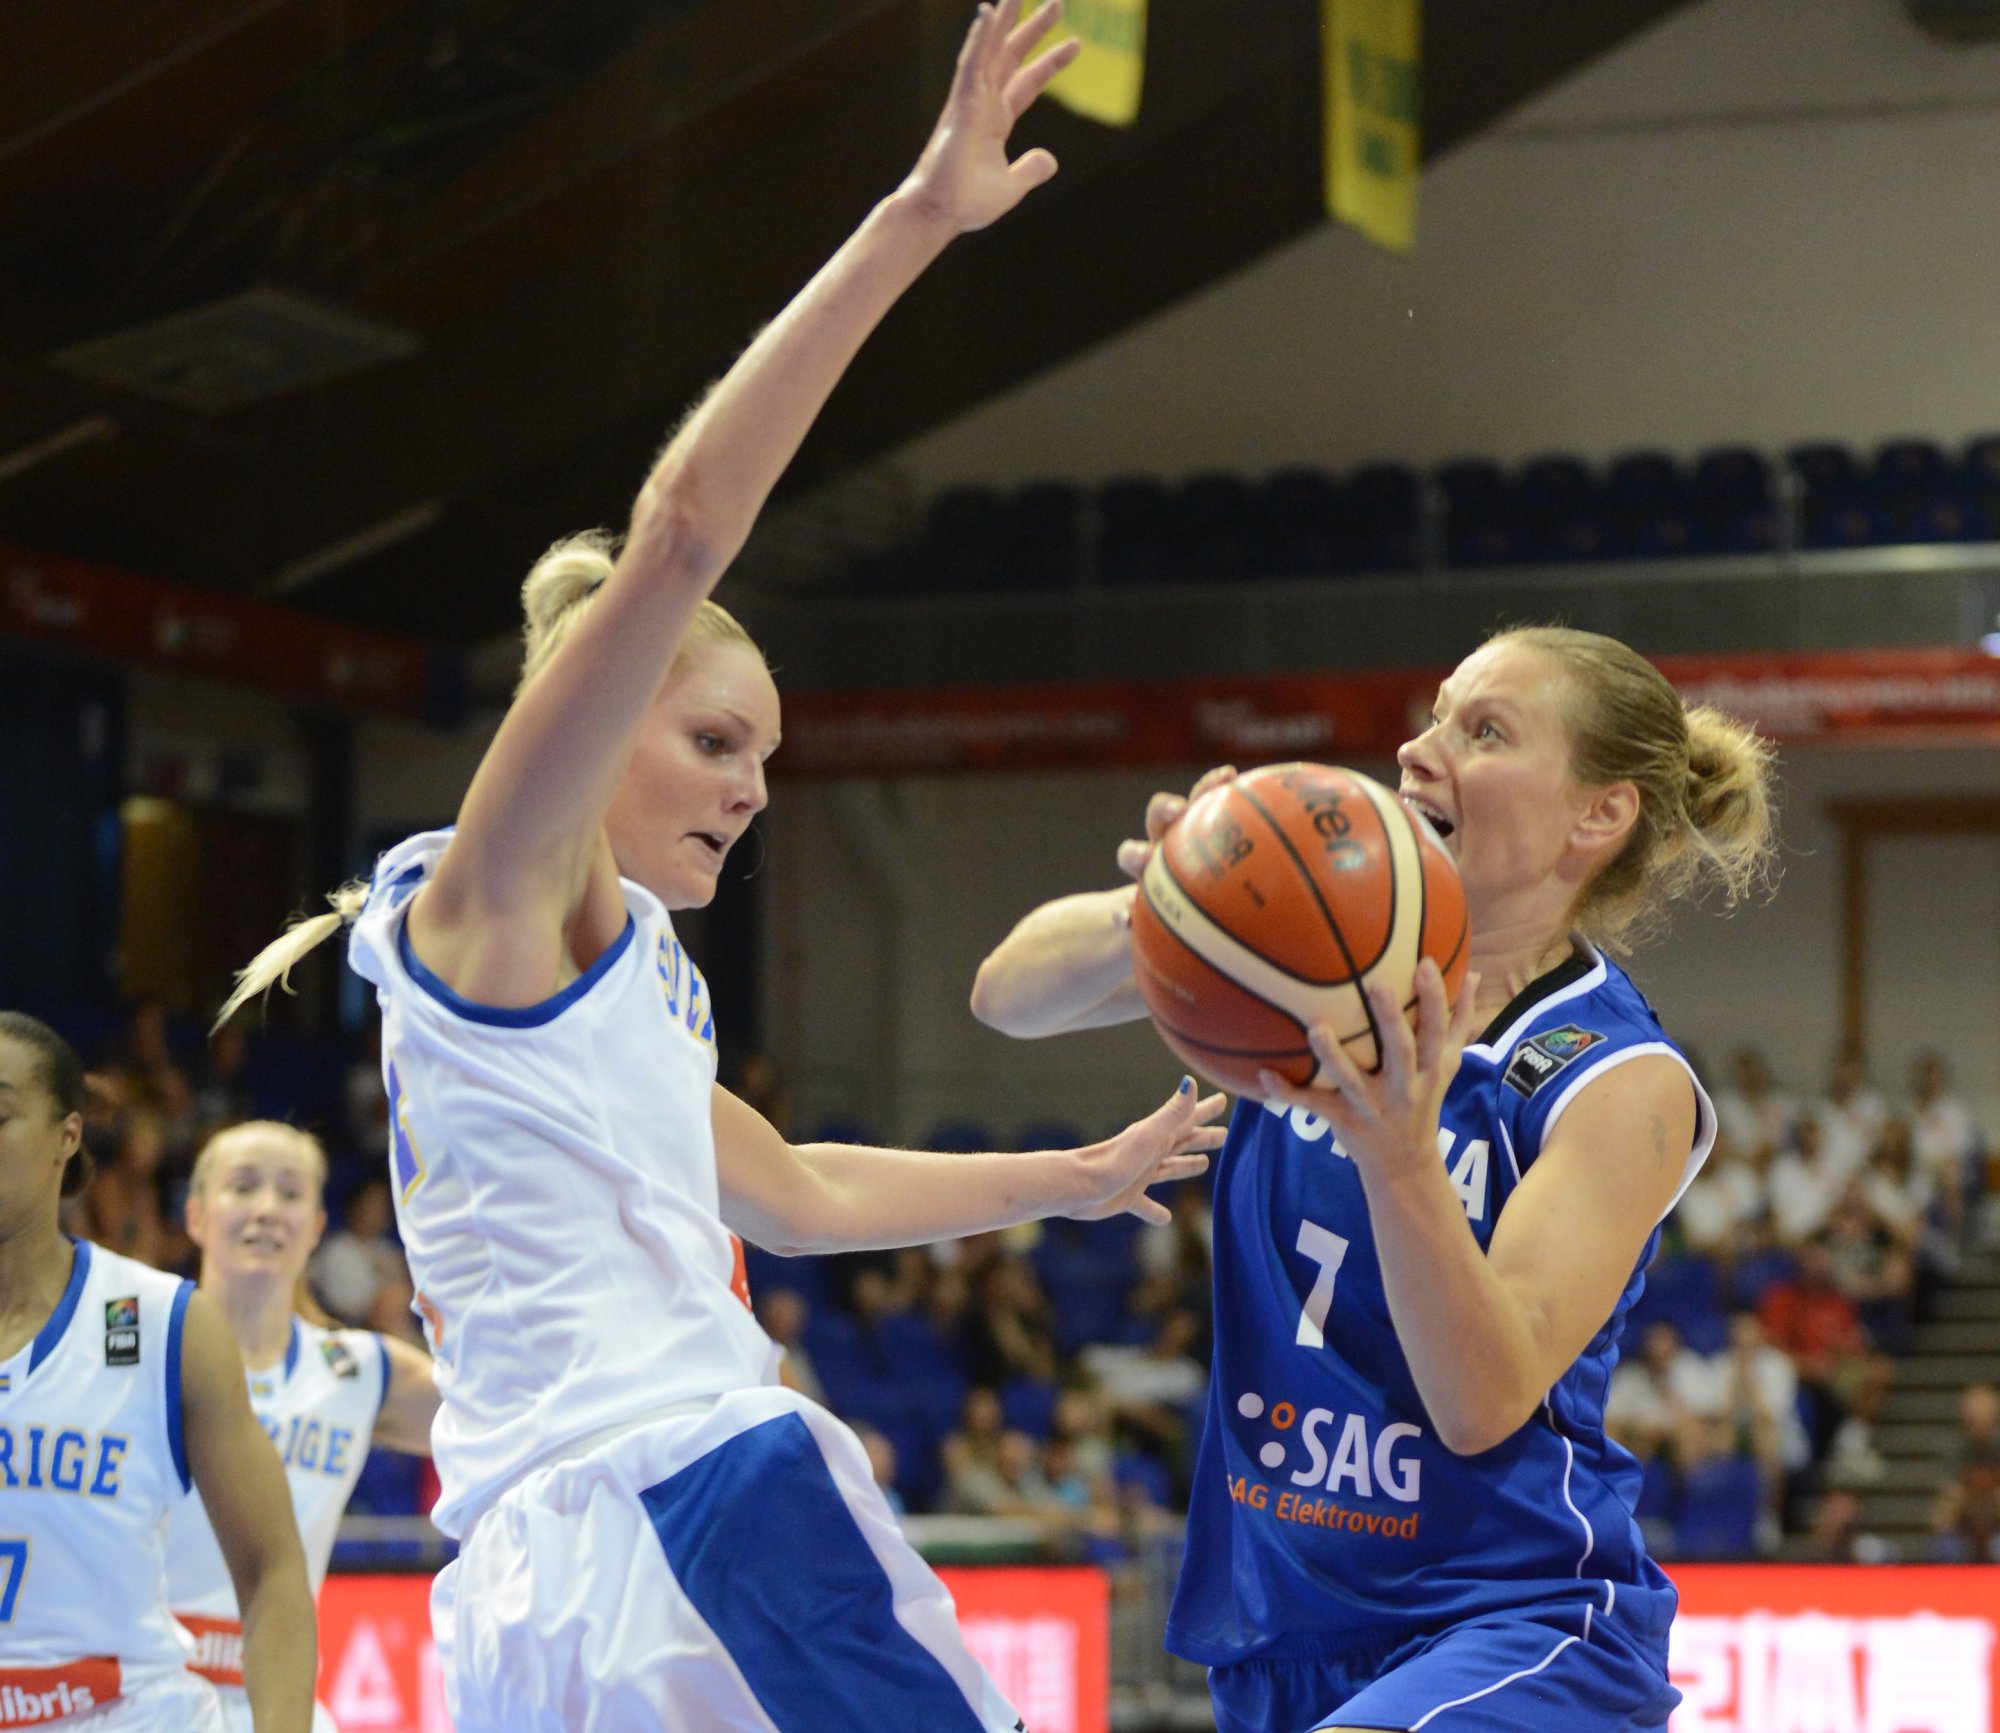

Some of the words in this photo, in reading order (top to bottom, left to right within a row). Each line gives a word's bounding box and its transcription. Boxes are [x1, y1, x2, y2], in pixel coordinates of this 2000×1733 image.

[1517, 1045, 1554, 1075] FIBA
[1296, 1218, 1350, 1350] 7
[1290, 1407, 1422, 1502] SAG
[1227, 1473, 1270, 1510] AG
[1275, 1492, 1419, 1540] Elektrovod
